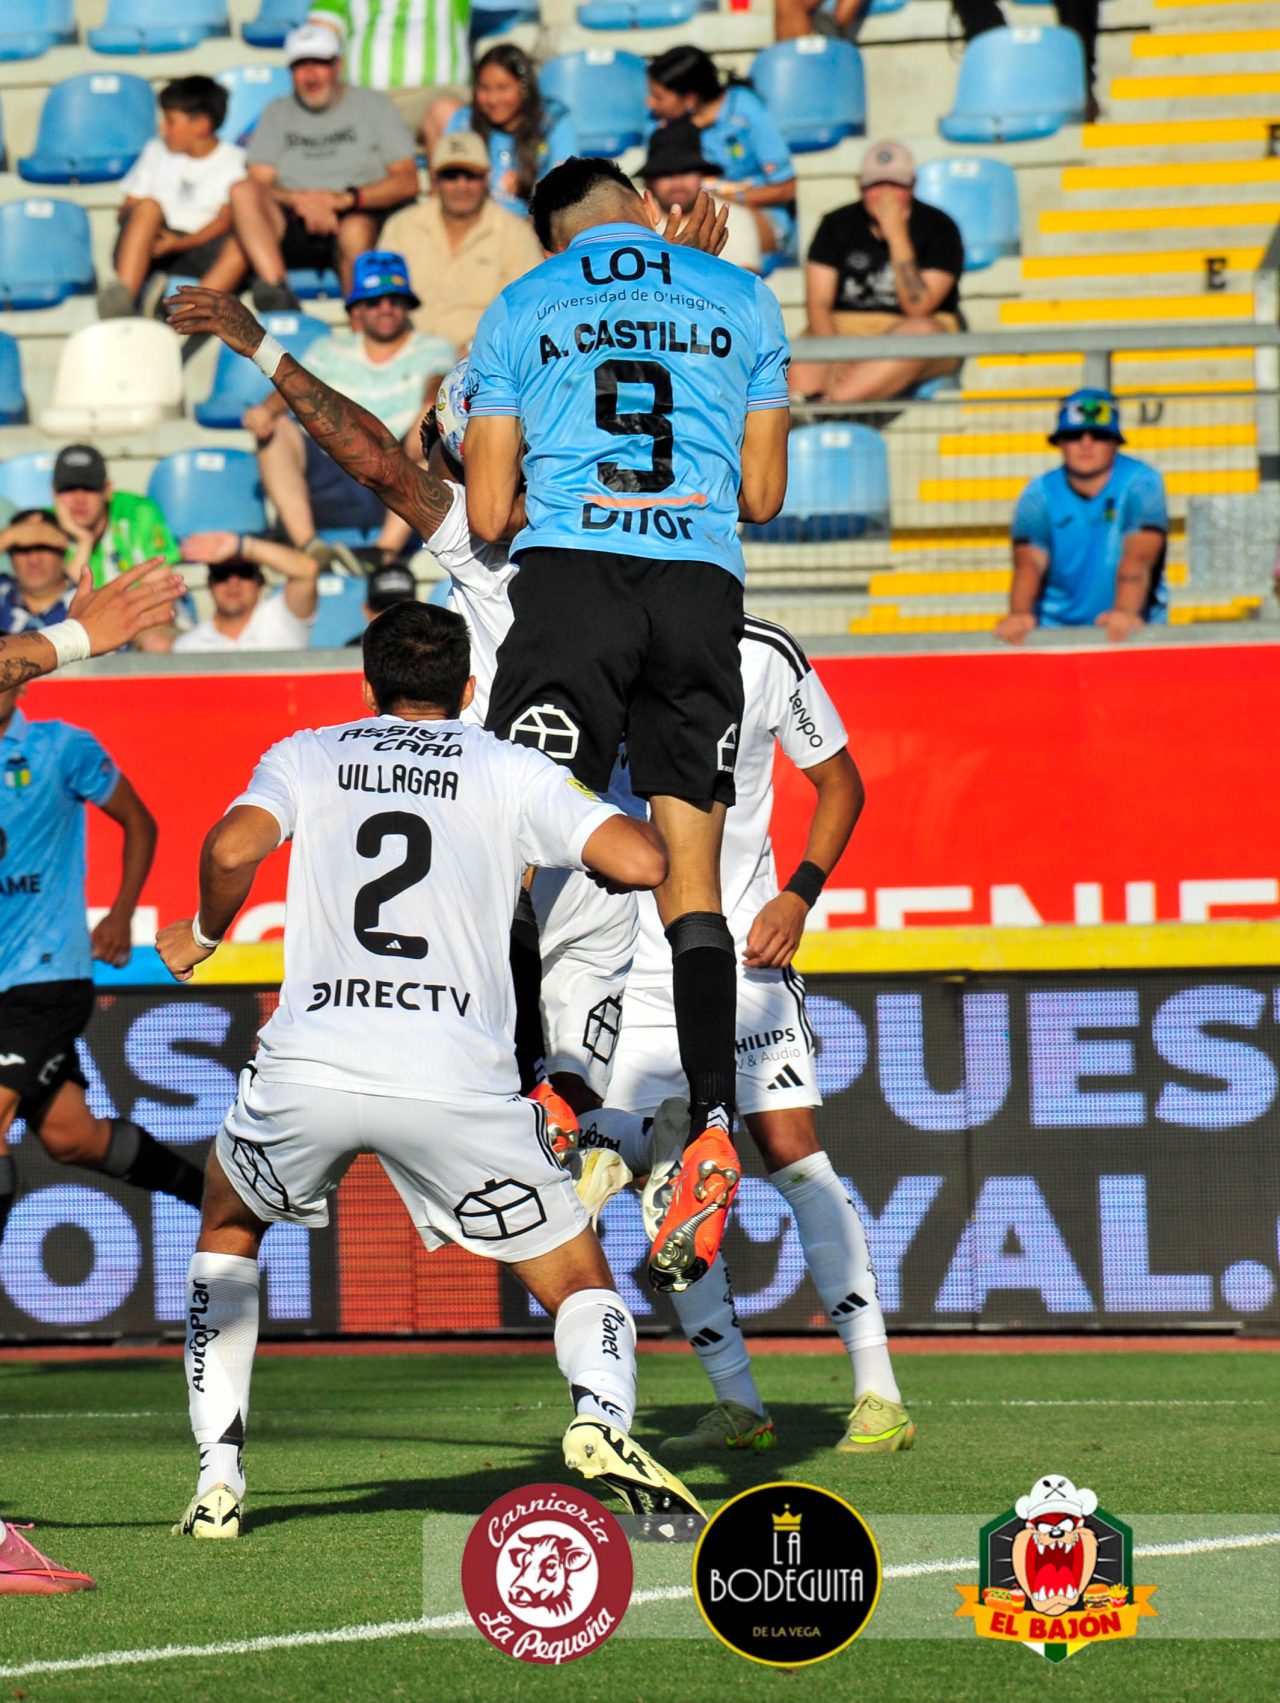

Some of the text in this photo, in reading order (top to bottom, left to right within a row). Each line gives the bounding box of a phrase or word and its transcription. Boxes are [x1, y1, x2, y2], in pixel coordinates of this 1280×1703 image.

[1205, 257, 1228, 291] E
[536, 288, 727, 321] Universidad de O'Higgins
[539, 319, 732, 366] A. CASTILLO
[594, 358, 675, 493] 9
[337, 725, 464, 743] ASSIST
[372, 738, 464, 758] CARD
[337, 763, 459, 801] VILLAGRA
[353, 810, 432, 960] 2
[305, 978, 472, 1018] DIRECTV
[735, 1027, 796, 1054] HILIPS
[747, 1054, 757, 1068] &
[760, 1046, 801, 1065] Audio
